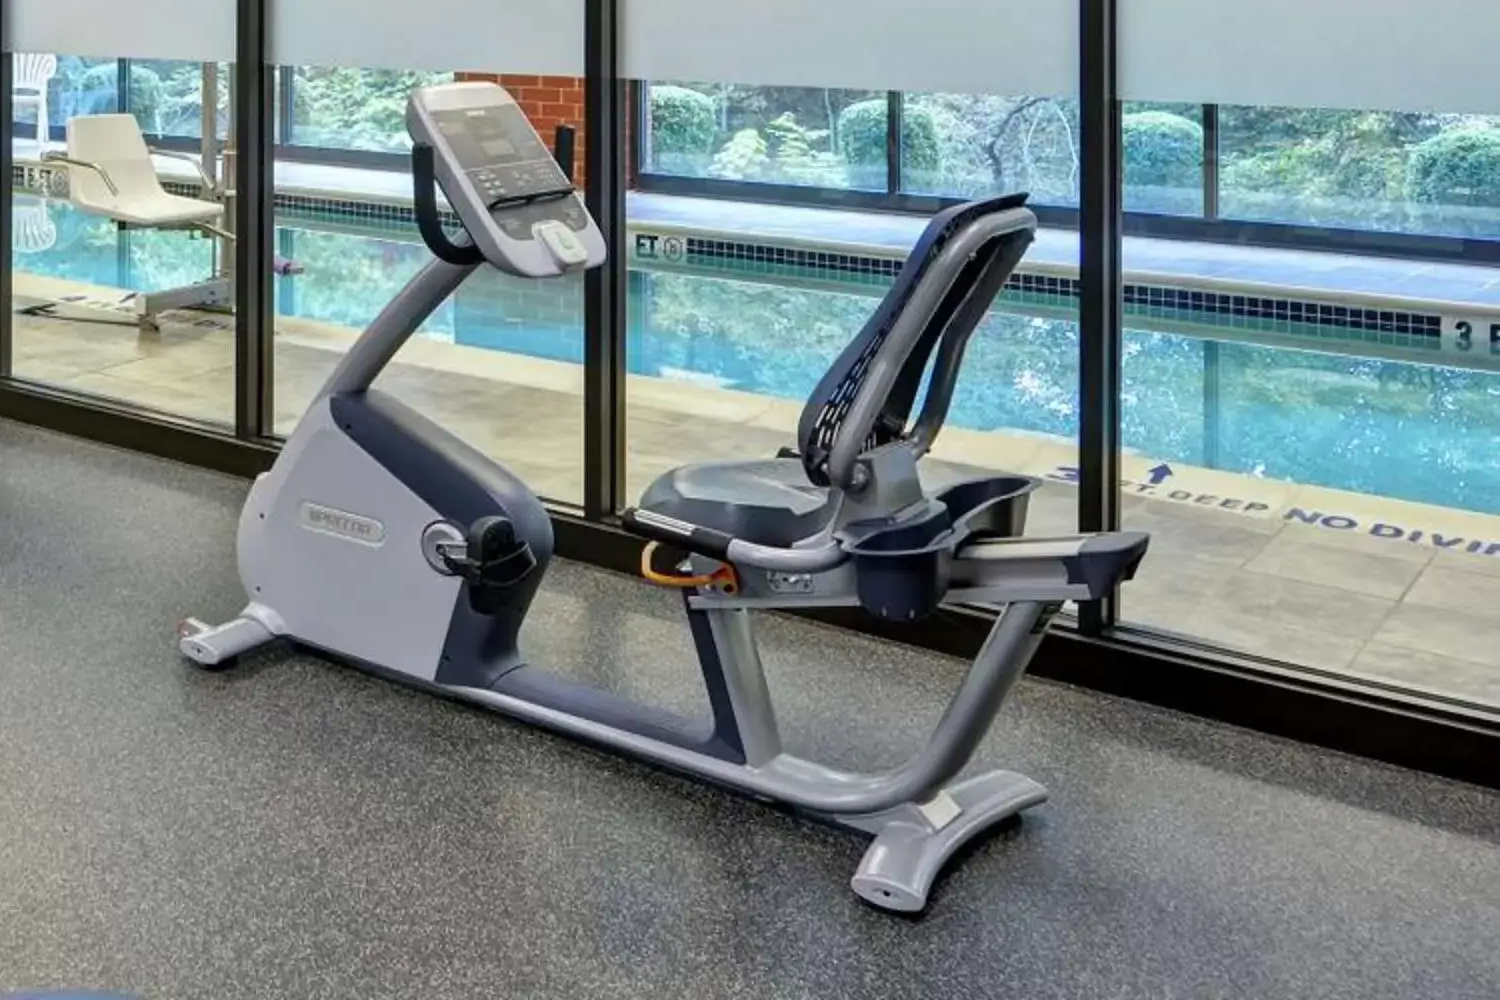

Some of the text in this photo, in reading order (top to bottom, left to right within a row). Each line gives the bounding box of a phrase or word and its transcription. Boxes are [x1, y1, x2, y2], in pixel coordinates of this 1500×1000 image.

[635, 233, 659, 253] FT
[1169, 490, 1269, 512] DEEP
[1283, 507, 1358, 529] NO
